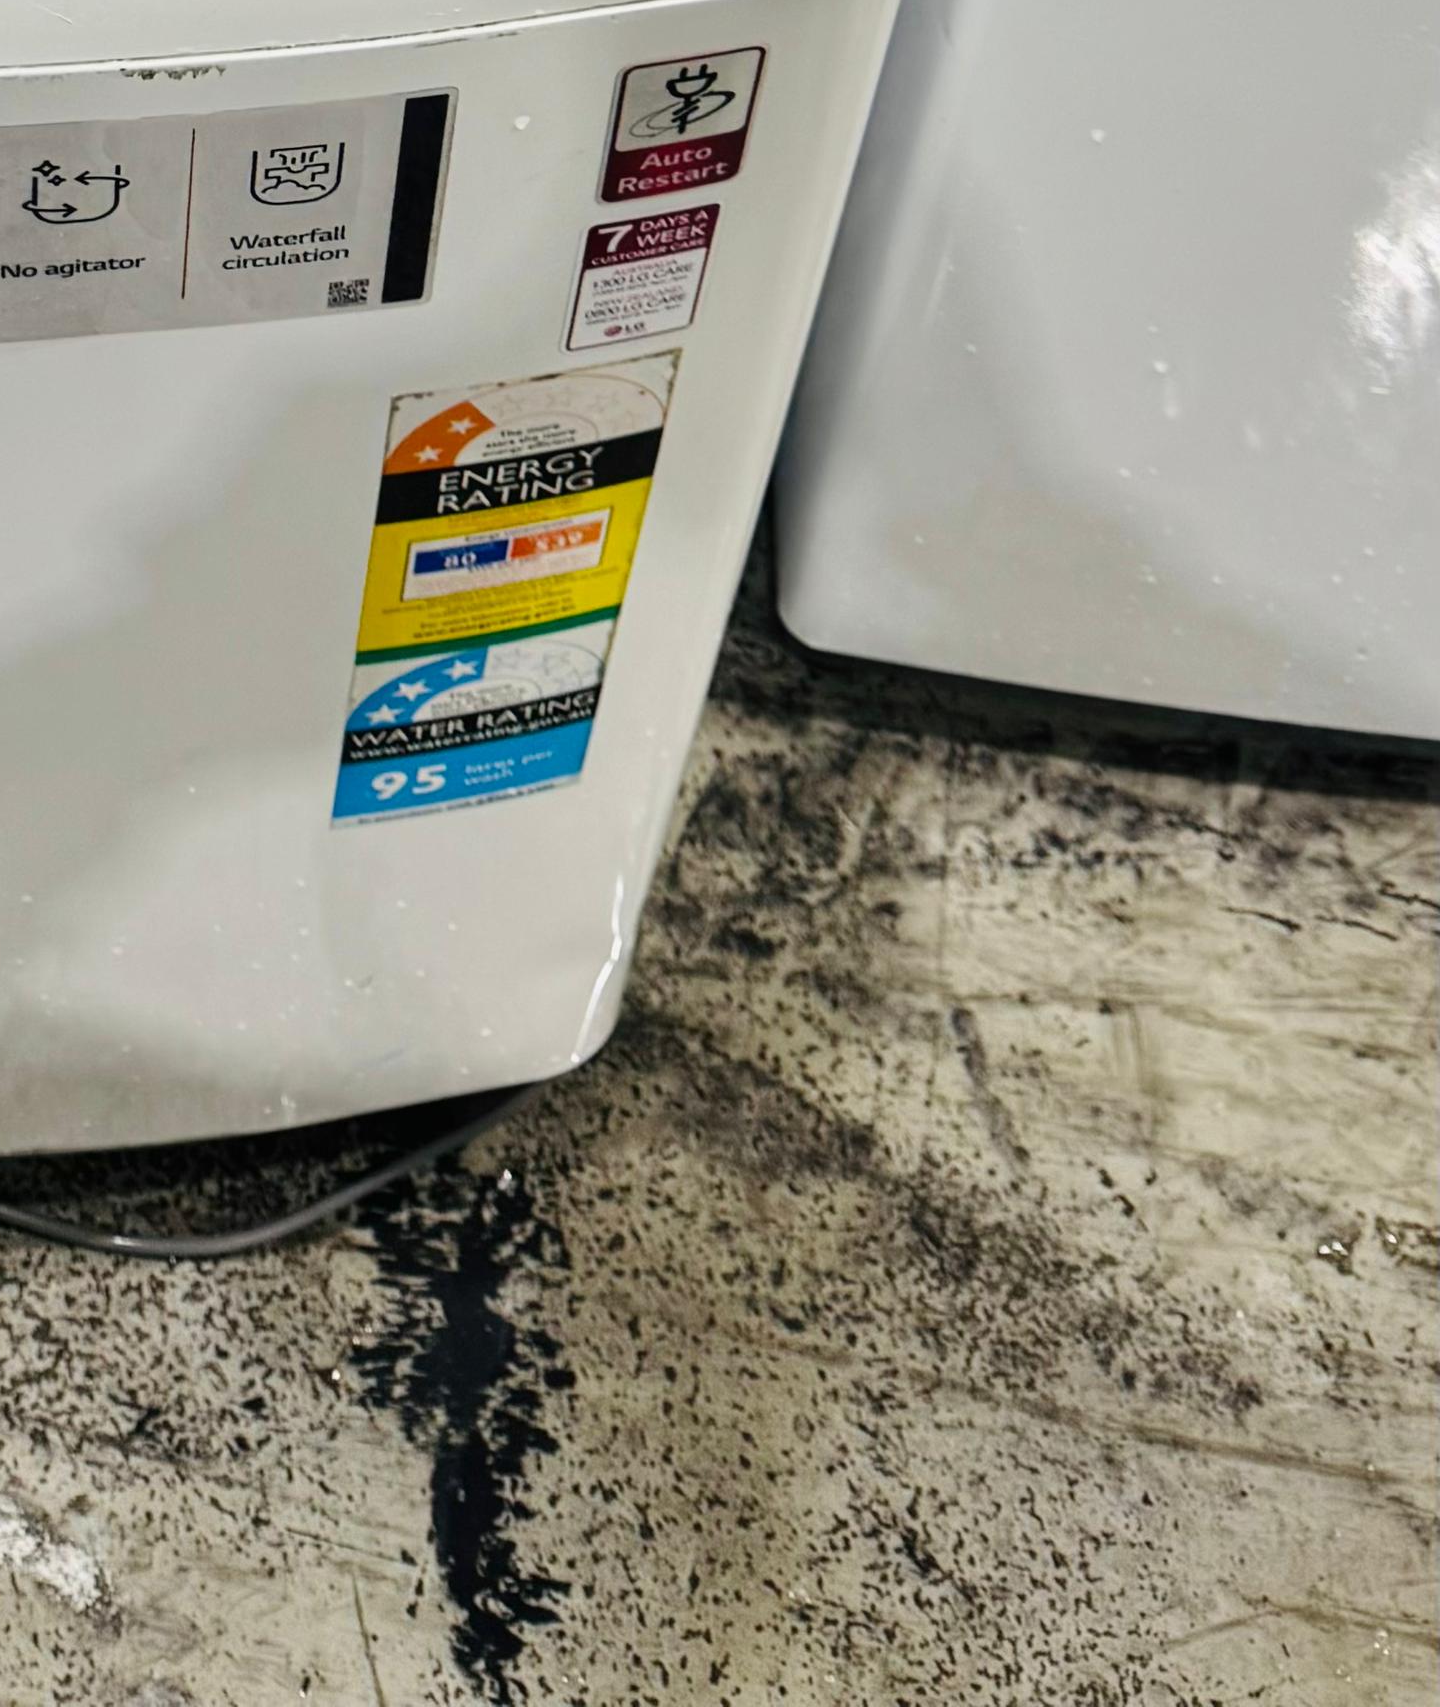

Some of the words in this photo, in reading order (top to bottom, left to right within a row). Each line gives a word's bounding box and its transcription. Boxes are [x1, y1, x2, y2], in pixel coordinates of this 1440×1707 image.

[640, 146, 713, 171] Auto
[617, 161, 729, 195] Restart
[229, 225, 347, 251] Waterfall
[598, 224, 634, 254] 7
[639, 213, 691, 233] DAYS
[694, 210, 709, 222] A
[636, 223, 708, 248] WEEK
[0, 263, 38, 279] No
[44, 254, 146, 278] agitator
[221, 245, 350, 271] circulation
[591, 245, 668, 266] CUSTOMER
[439, 446, 605, 493] ENERGY
[436, 469, 596, 515] RATING
[351, 719, 466, 749] WATER
[476, 690, 596, 730] RATING
[371, 763, 447, 801] 95
